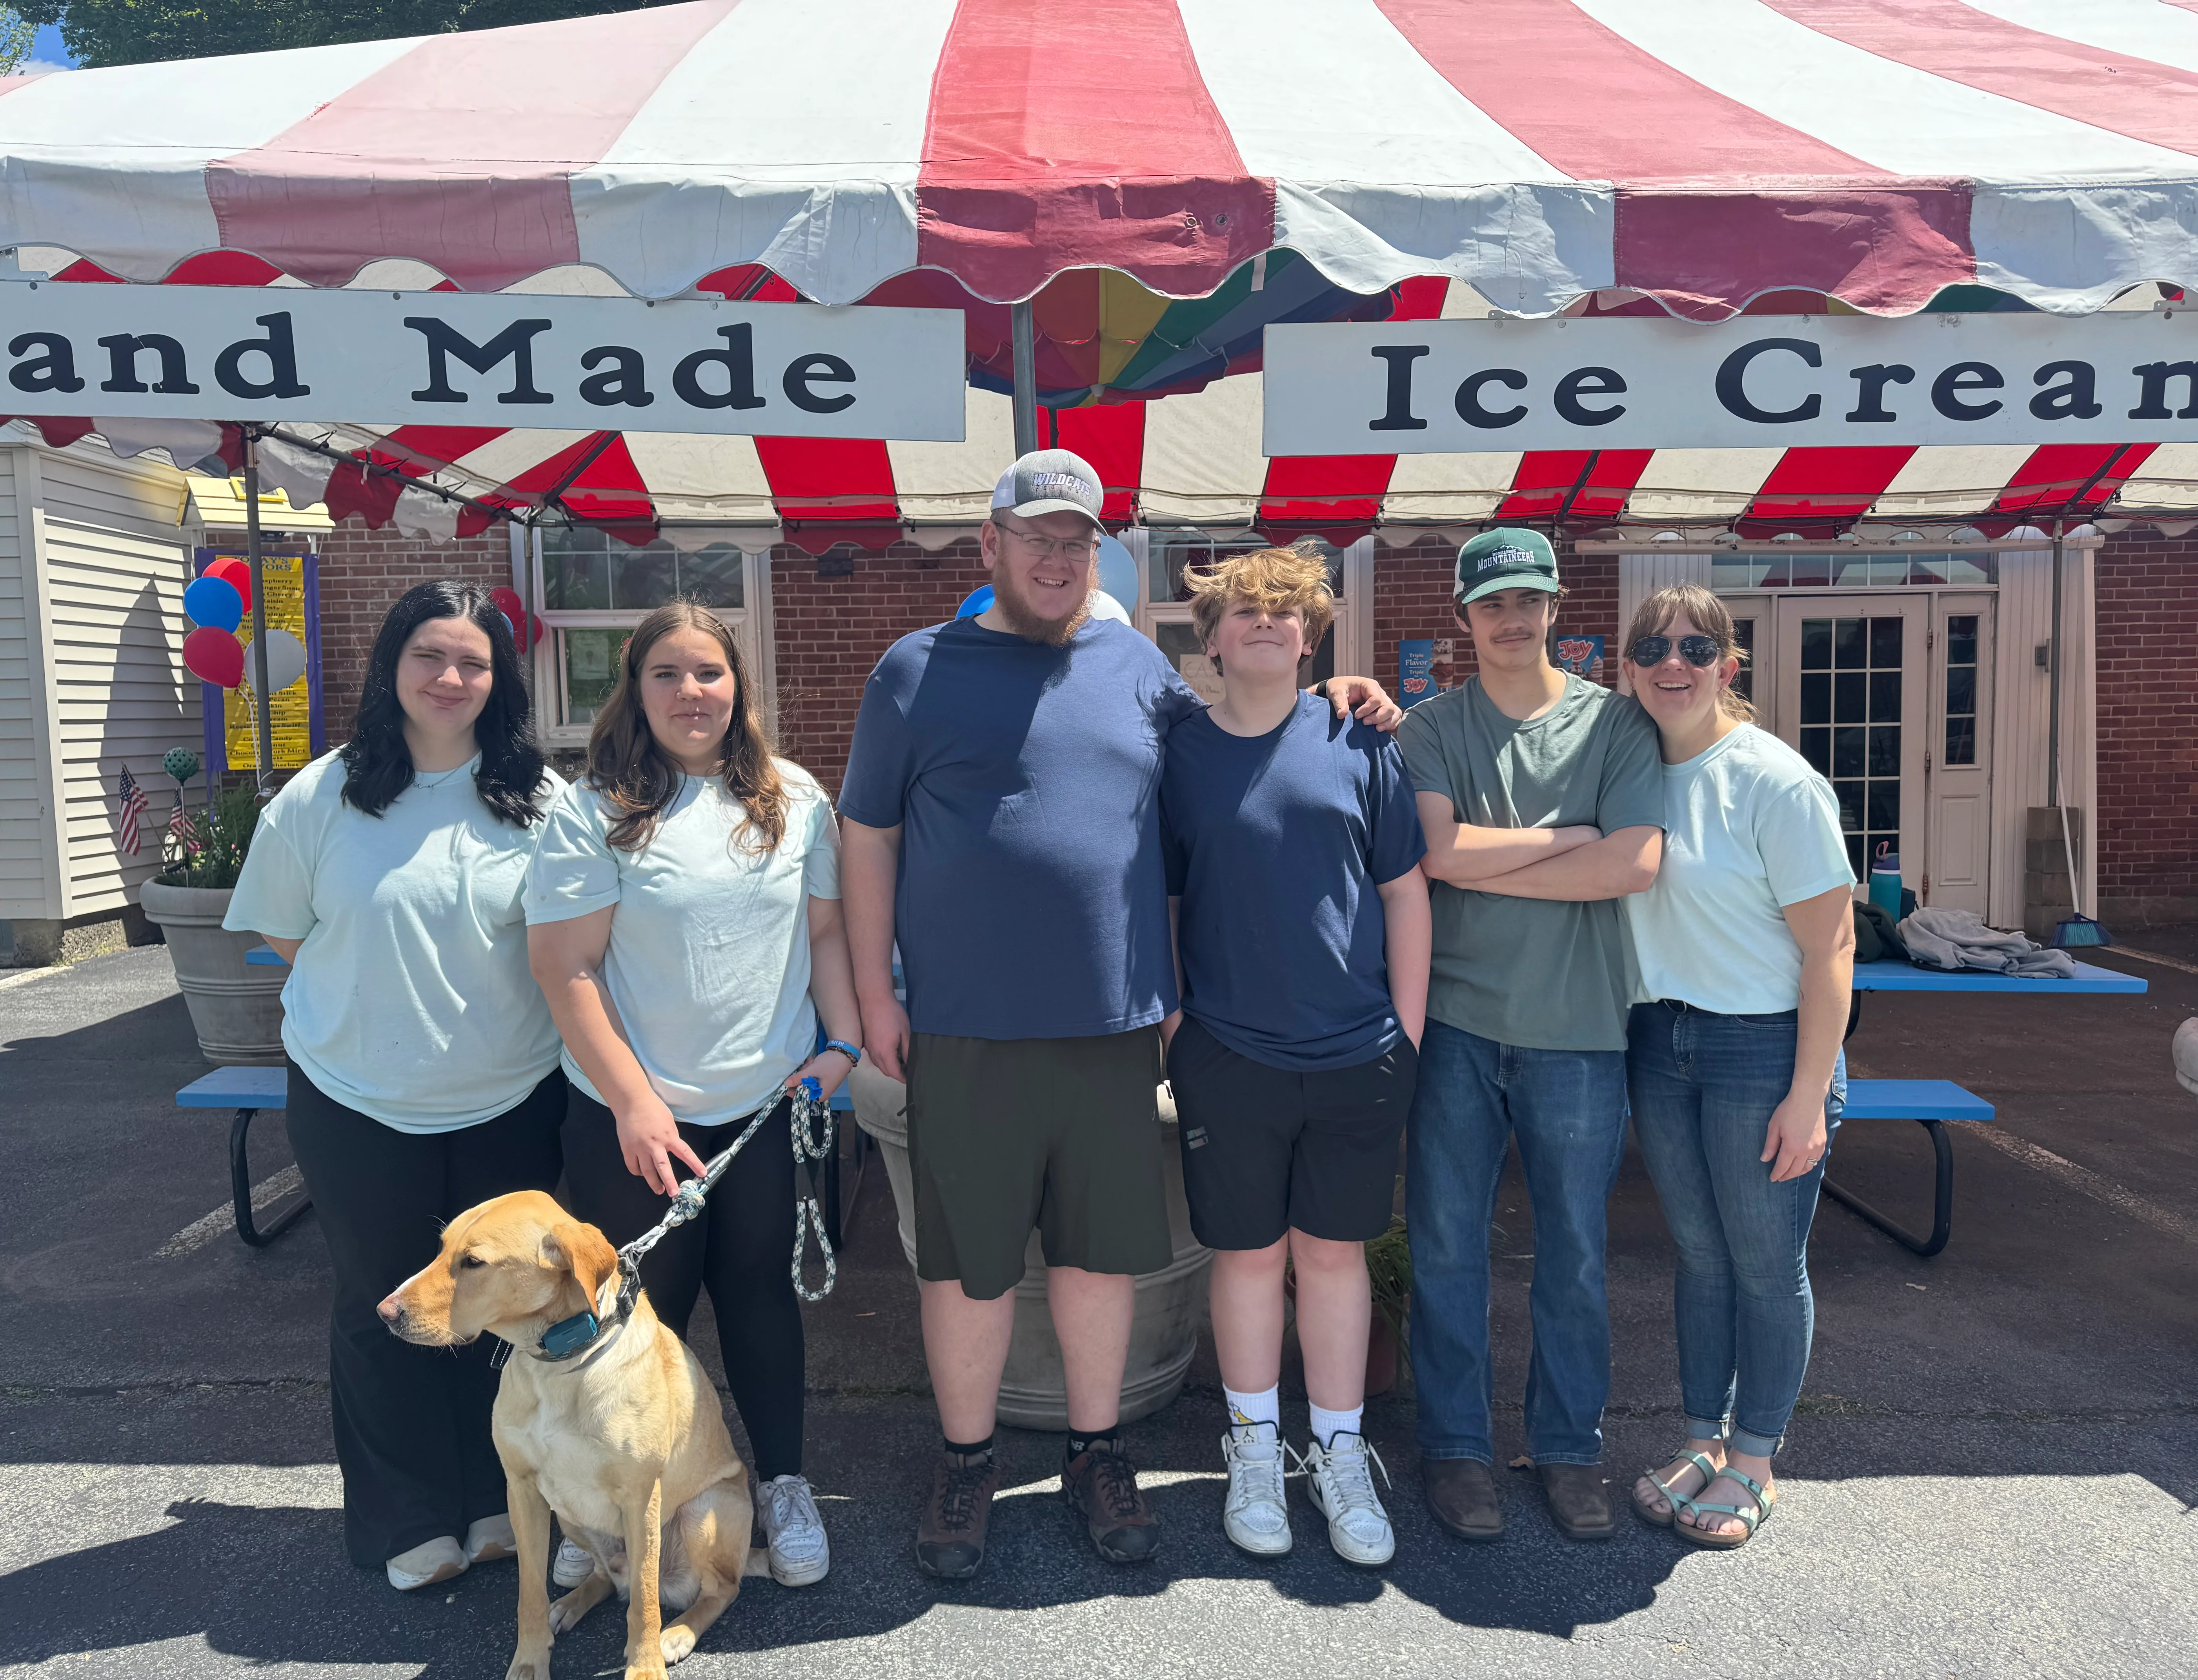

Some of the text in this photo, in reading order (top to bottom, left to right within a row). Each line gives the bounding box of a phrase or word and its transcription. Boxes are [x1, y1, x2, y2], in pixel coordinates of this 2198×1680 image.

[404, 317, 857, 414] Made
[1370, 345, 1627, 431] Ice
[1032, 472, 1091, 496] WILDCATS
[1477, 550, 1535, 572] MOUNTAINEERS
